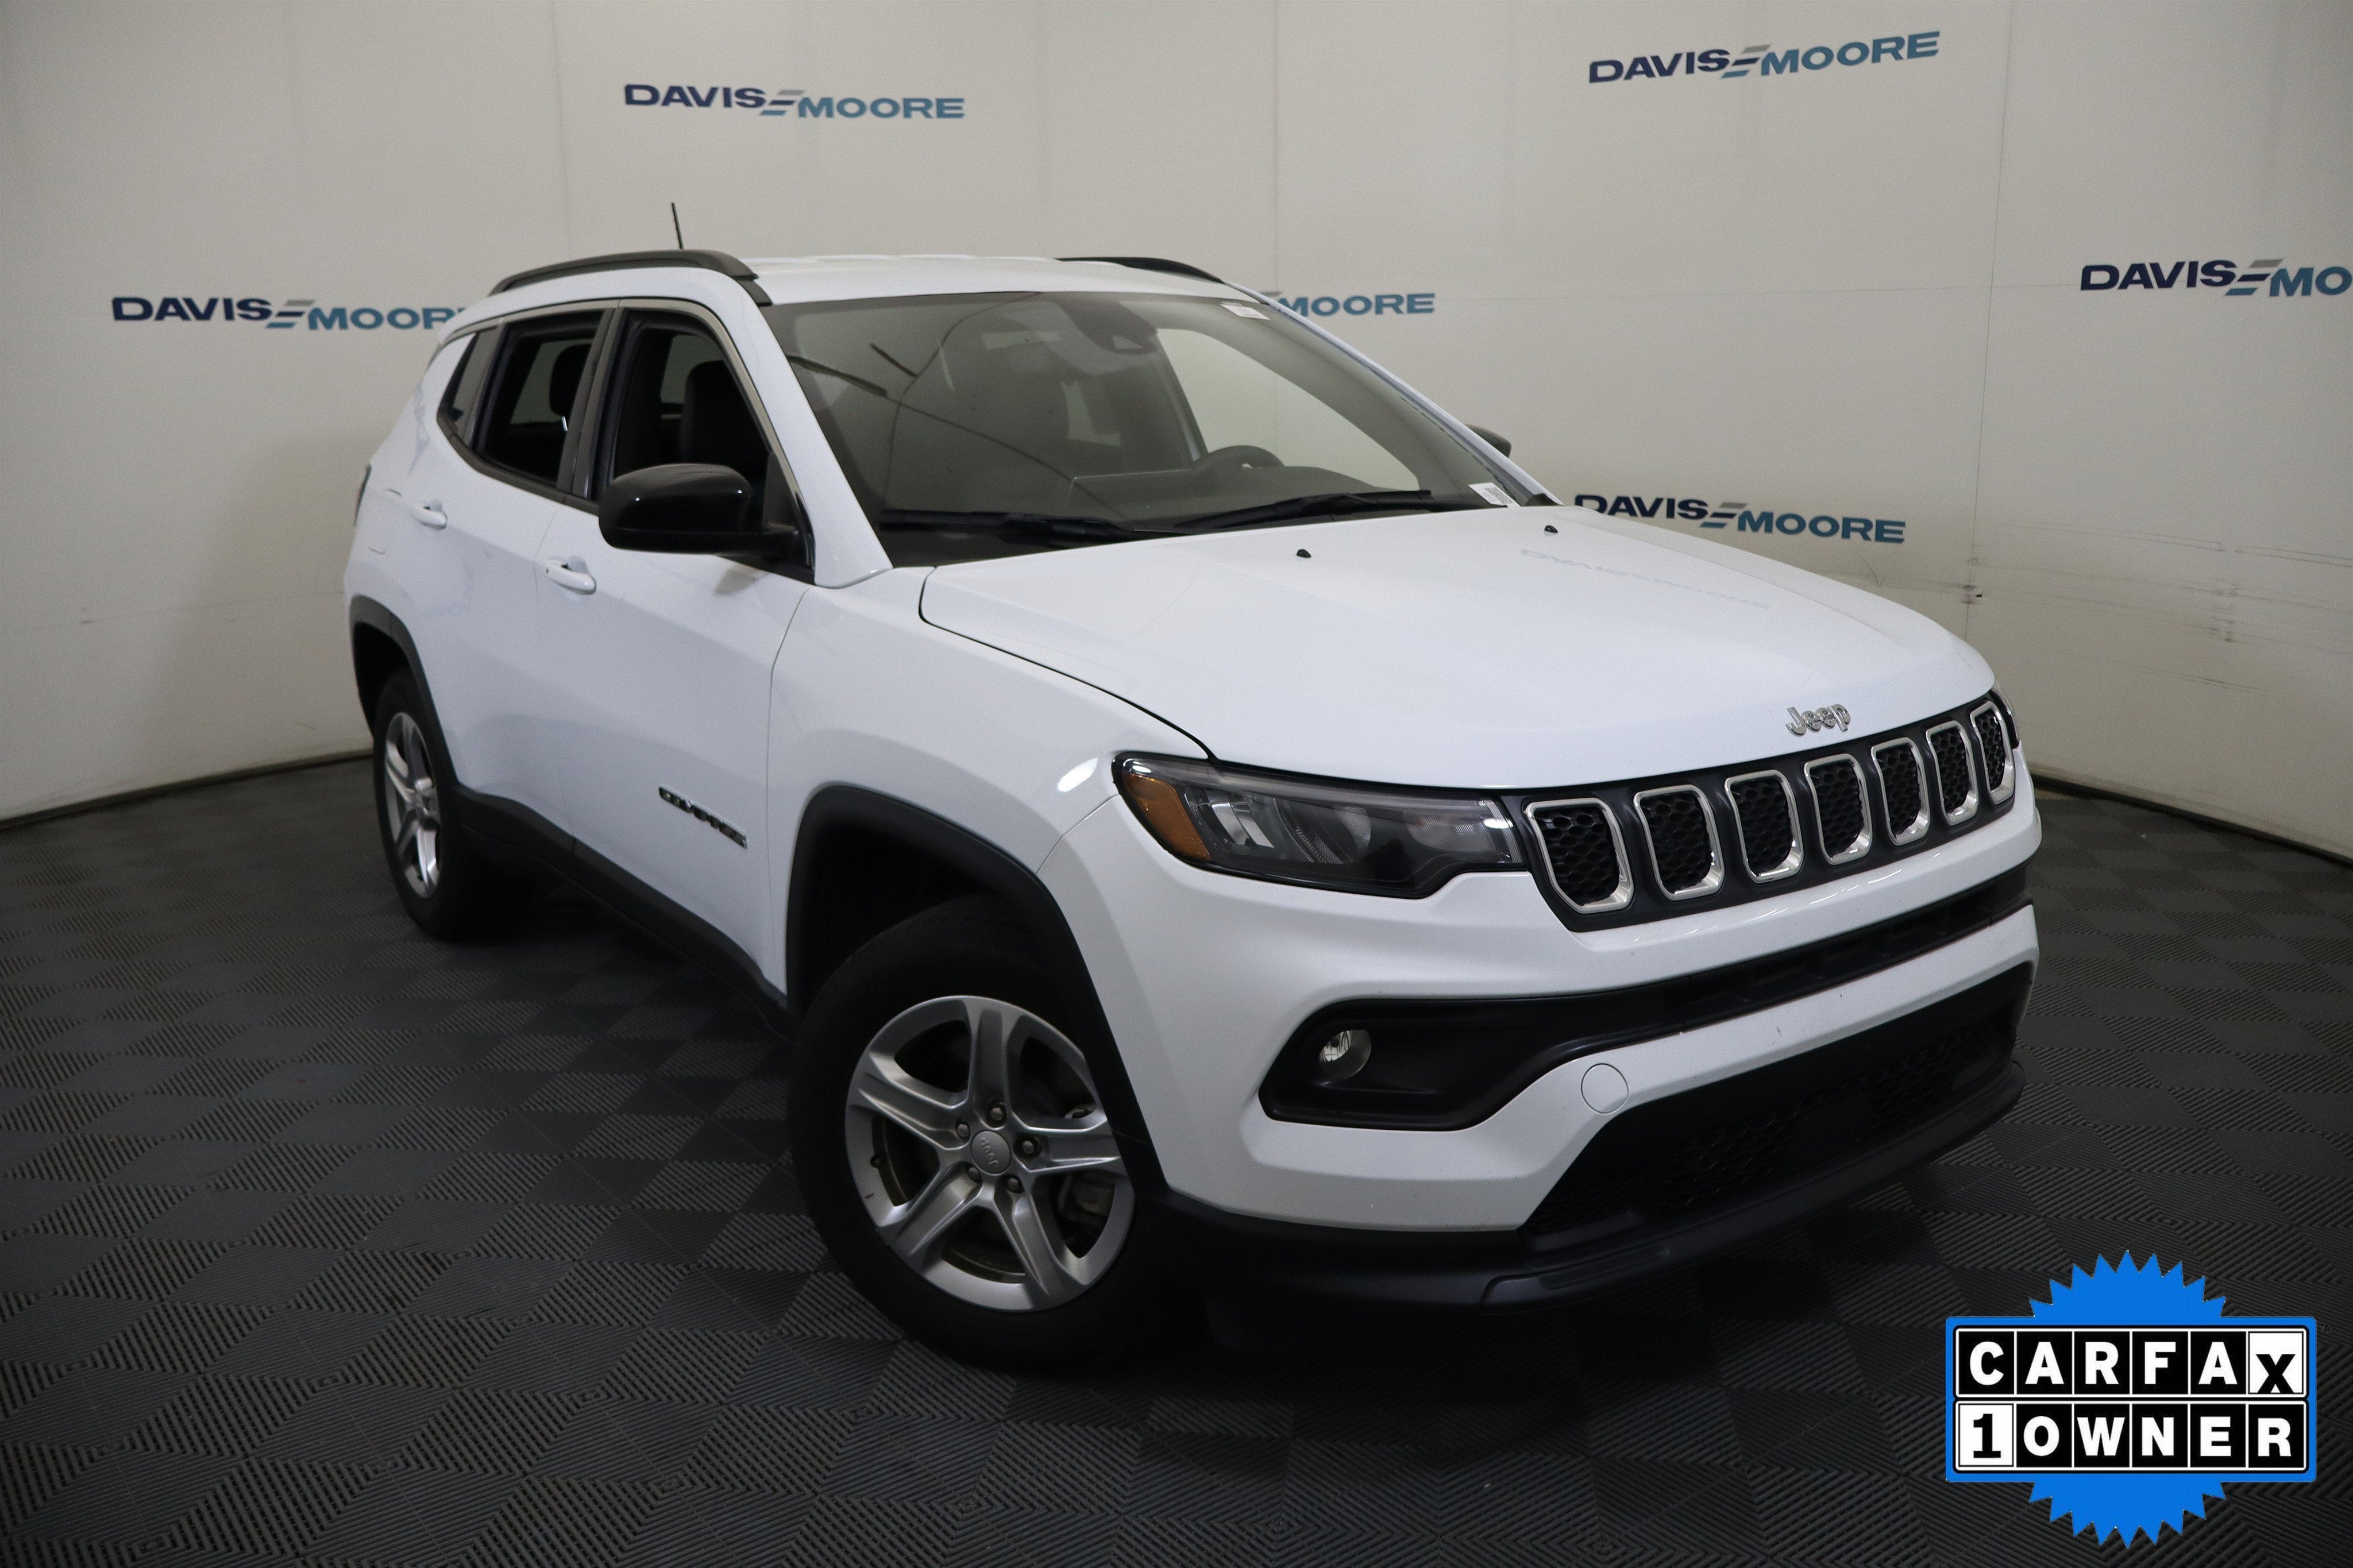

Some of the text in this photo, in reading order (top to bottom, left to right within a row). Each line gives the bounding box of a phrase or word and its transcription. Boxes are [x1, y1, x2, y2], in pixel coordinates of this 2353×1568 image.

[1587, 30, 1941, 83] DAVIS MOORE
[624, 84, 965, 119] DAVIS MOORE
[2080, 259, 2237, 291] DAVIS
[111, 296, 466, 330] DAVIS MOOR
[1278, 293, 1435, 318] MOORE
[1575, 495, 1906, 544] DAVIS MOORE
[1785, 704, 1851, 737] Jeep
